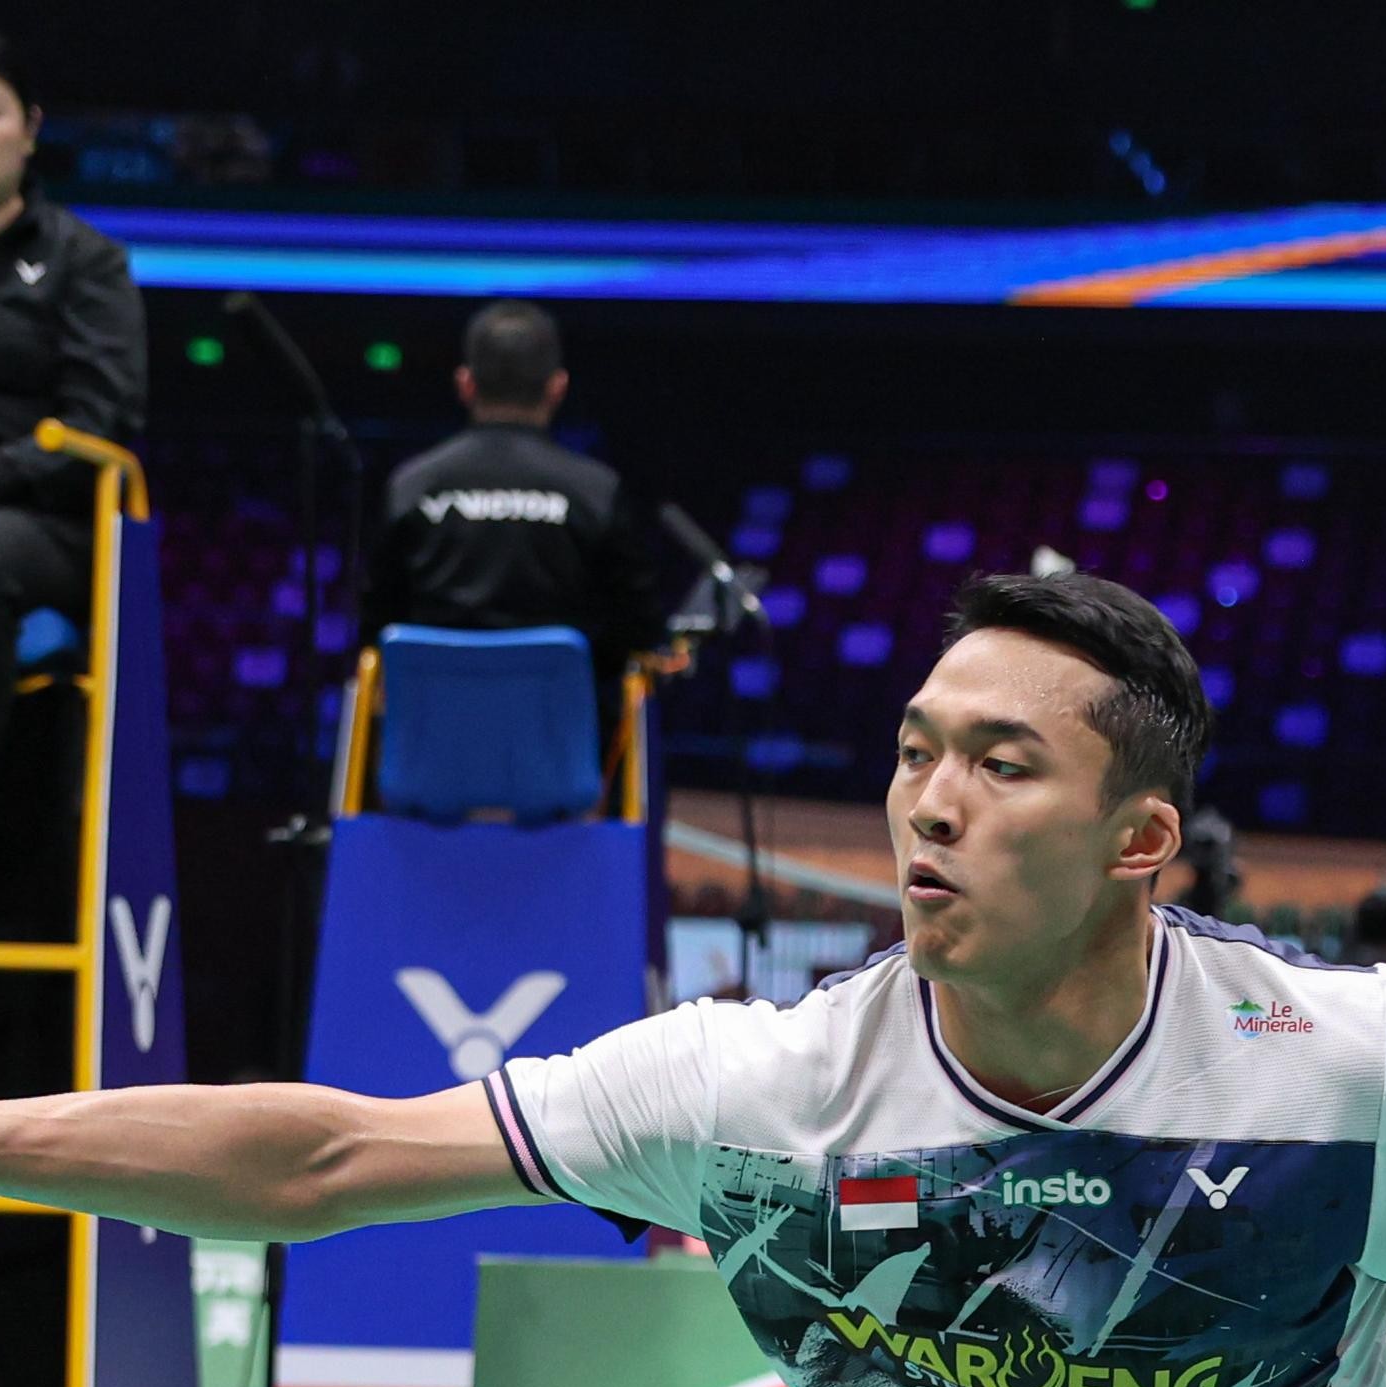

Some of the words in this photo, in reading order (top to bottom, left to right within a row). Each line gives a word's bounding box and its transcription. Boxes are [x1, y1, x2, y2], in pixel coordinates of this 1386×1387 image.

[1271, 1001, 1292, 1018] Le
[1234, 1016, 1313, 1033] Minerale
[1002, 1170, 1112, 1206] insto
